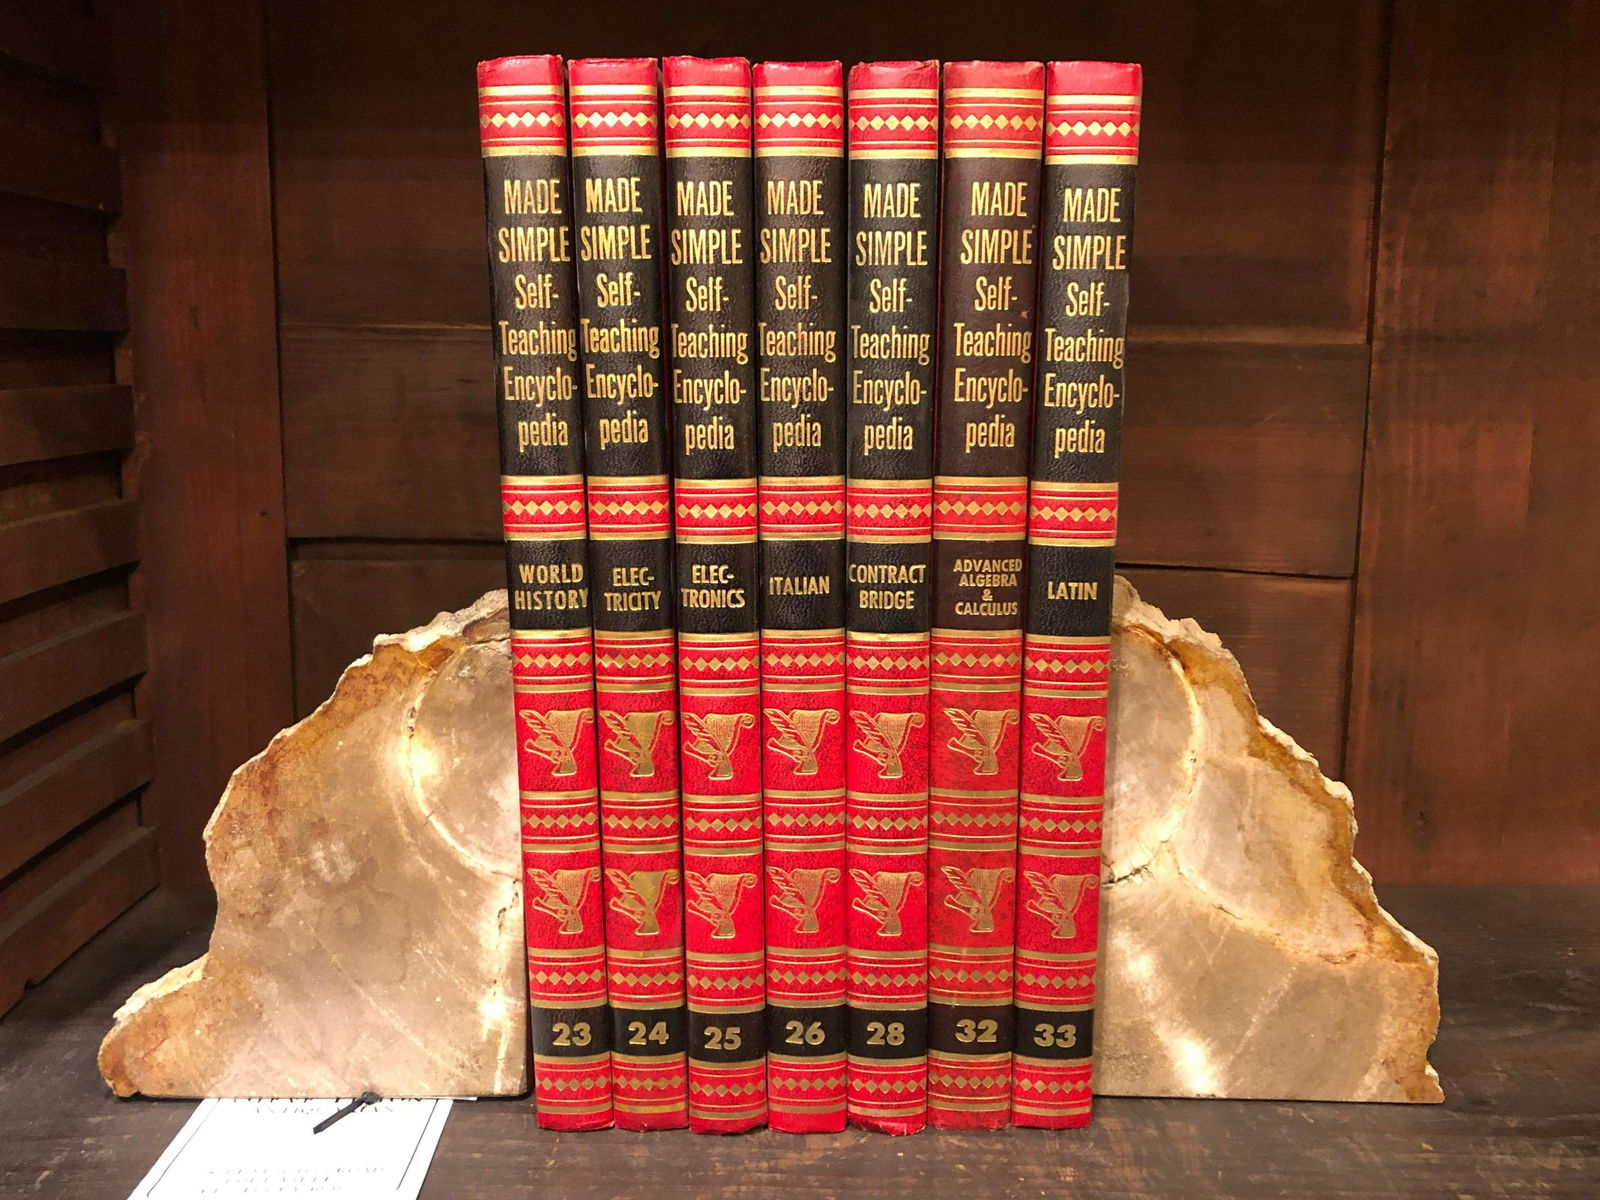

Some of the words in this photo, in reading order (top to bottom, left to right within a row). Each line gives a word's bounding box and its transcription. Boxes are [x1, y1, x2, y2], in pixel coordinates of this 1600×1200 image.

[504, 179, 562, 215] MADE
[586, 177, 642, 213] MADE
[677, 180, 734, 216] MADE
[767, 181, 823, 215] MADE
[864, 183, 921, 218] MADE
[971, 182, 1027, 217] MADE
[1063, 187, 1121, 223] MADE
[498, 226, 570, 263] SIMPLE
[581, 224, 652, 261] SIMPLE
[671, 229, 743, 265] SIMPLE
[760, 228, 831, 264] SIMPLE
[856, 231, 927, 266] SIMPLE
[960, 229, 1032, 265] SIMPLE
[1052, 235, 1126, 270] SIMPLE
[515, 274, 559, 310] Self-
[597, 272, 641, 308] Self-
[685, 277, 729, 312] Self-
[775, 275, 817, 309] Self-
[869, 278, 912, 313] Self-
[974, 276, 1017, 311] Self-
[1066, 282, 1110, 317] Self-
[499, 321, 577, 361] Teaching
[581, 319, 659, 359] Teaching
[672, 323, 748, 365] Teaching
[759, 323, 836, 363] Teaching
[851, 325, 929, 366] Teaching
[954, 322, 1032, 364] Teaching
[1045, 328, 1124, 369] Teaching
[503, 367, 577, 408] Encyclo-
[586, 365, 658, 405] Encyclo-
[674, 369, 746, 411] Encyclo-
[760, 368, 834, 408] Encyclo-
[852, 370, 927, 412] Encyclo-
[954, 368, 1028, 409] Encyclo-
[1044, 373, 1119, 415] Encyclo-
[518, 413, 568, 452] pedia
[599, 411, 648, 450] pedia
[685, 416, 734, 455] pedia
[773, 415, 821, 453] pedia
[864, 416, 913, 455] pedia
[966, 415, 1015, 453] pedia
[1054, 420, 1105, 458] pedia
[519, 564, 583, 583] WORLD
[613, 567, 654, 587] ELEC-
[692, 564, 734, 584] ELEC-
[848, 564, 926, 584] CONTRACT
[953, 558, 1022, 573] ADVANCED
[959, 574, 1017, 587] ALGEBRA
[515, 588, 589, 610] HISTORY
[604, 591, 661, 612] TRICITY
[681, 588, 745, 609] TRONICS
[769, 576, 829, 595] ITALIAN
[859, 590, 914, 610] BRIDGE
[982, 589, 993, 600] &
[1048, 581, 1098, 600] LATIN
[955, 602, 1018, 616] CALCULUS
[552, 1023, 592, 1046] 23
[628, 1021, 669, 1044] 24
[704, 1026, 742, 1049] 25
[785, 1021, 825, 1044] 26
[866, 1022, 905, 1045] 28
[955, 1019, 998, 1043] 32
[1034, 1024, 1077, 1047] 33
